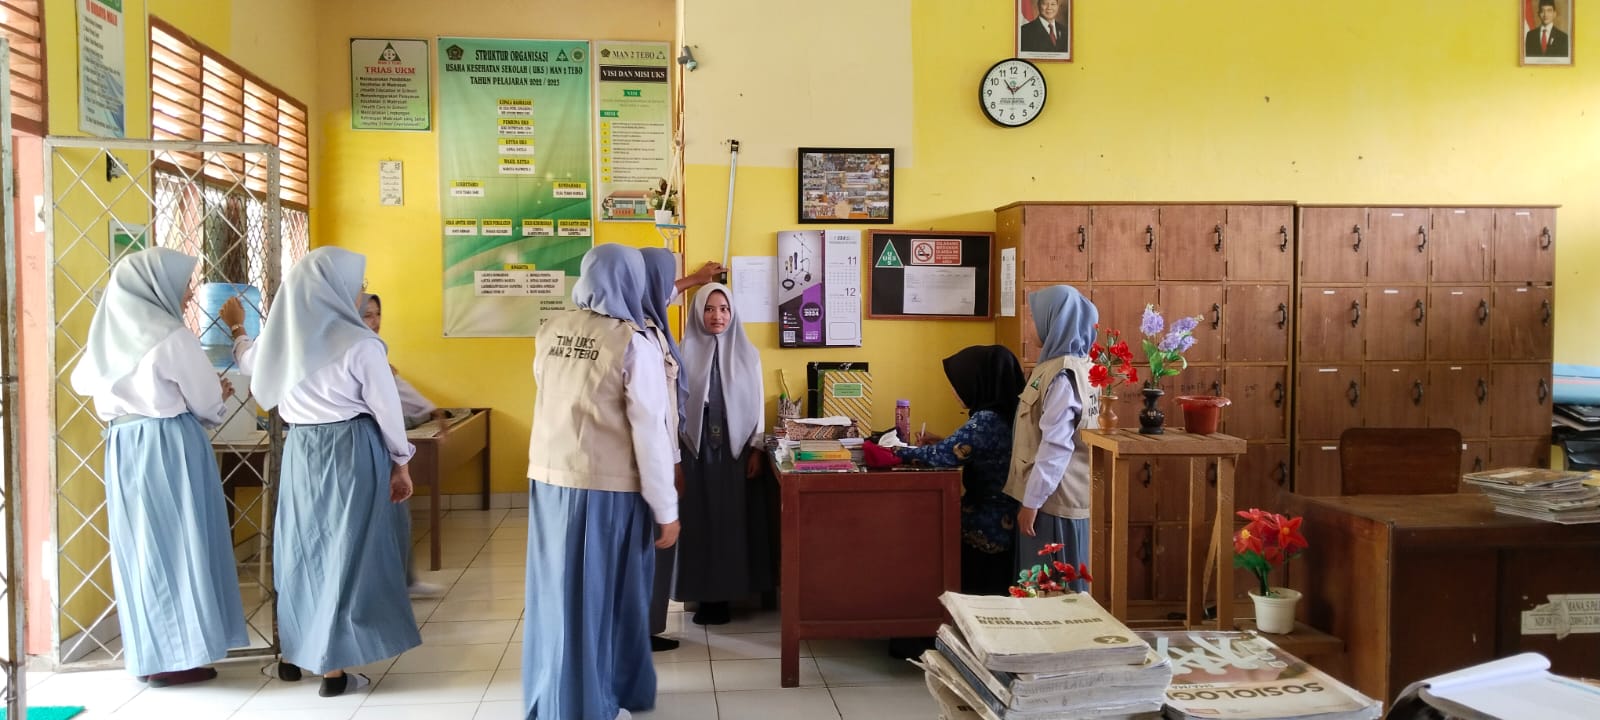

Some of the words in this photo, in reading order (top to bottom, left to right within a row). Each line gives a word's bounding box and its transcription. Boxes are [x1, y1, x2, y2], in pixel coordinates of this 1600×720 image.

[475, 50, 508, 61] STRUKTUR
[510, 50, 549, 62] ORGANISASI
[612, 50, 629, 58] MAN
[636, 51, 655, 60] TEBO
[364, 66, 392, 74] TRIAS
[394, 67, 415, 75] UKM
[445, 63, 466, 72] USAHA
[467, 64, 500, 73] KESEHATAN
[501, 65, 528, 74] SEKOLAH
[533, 65, 545, 74] UKS
[550, 66, 562, 74] MAN
[568, 66, 583, 75] TEBO
[1010, 66, 1018, 75] 12
[602, 69, 618, 77] VISI
[618, 70, 633, 78] DAN
[634, 70, 650, 78] MISI
[651, 71, 665, 79] UKS
[470, 76, 491, 85] TAHUN
[492, 77, 528, 86] PELAJARAN
[990, 77, 1000, 86] 10
[1031, 78, 1036, 86] 2
[1033, 89, 1039, 97] 3
[999, 109, 1004, 117] 7
[1022, 109, 1027, 117] 5
[847, 256, 857, 265] 11
[845, 287, 856, 297] 12
[557, 335, 574, 346] TIM
[575, 336, 596, 349] UKS
[548, 346, 565, 357] MAN
[565, 347, 573, 357] 2
[574, 347, 599, 361] TEBO
